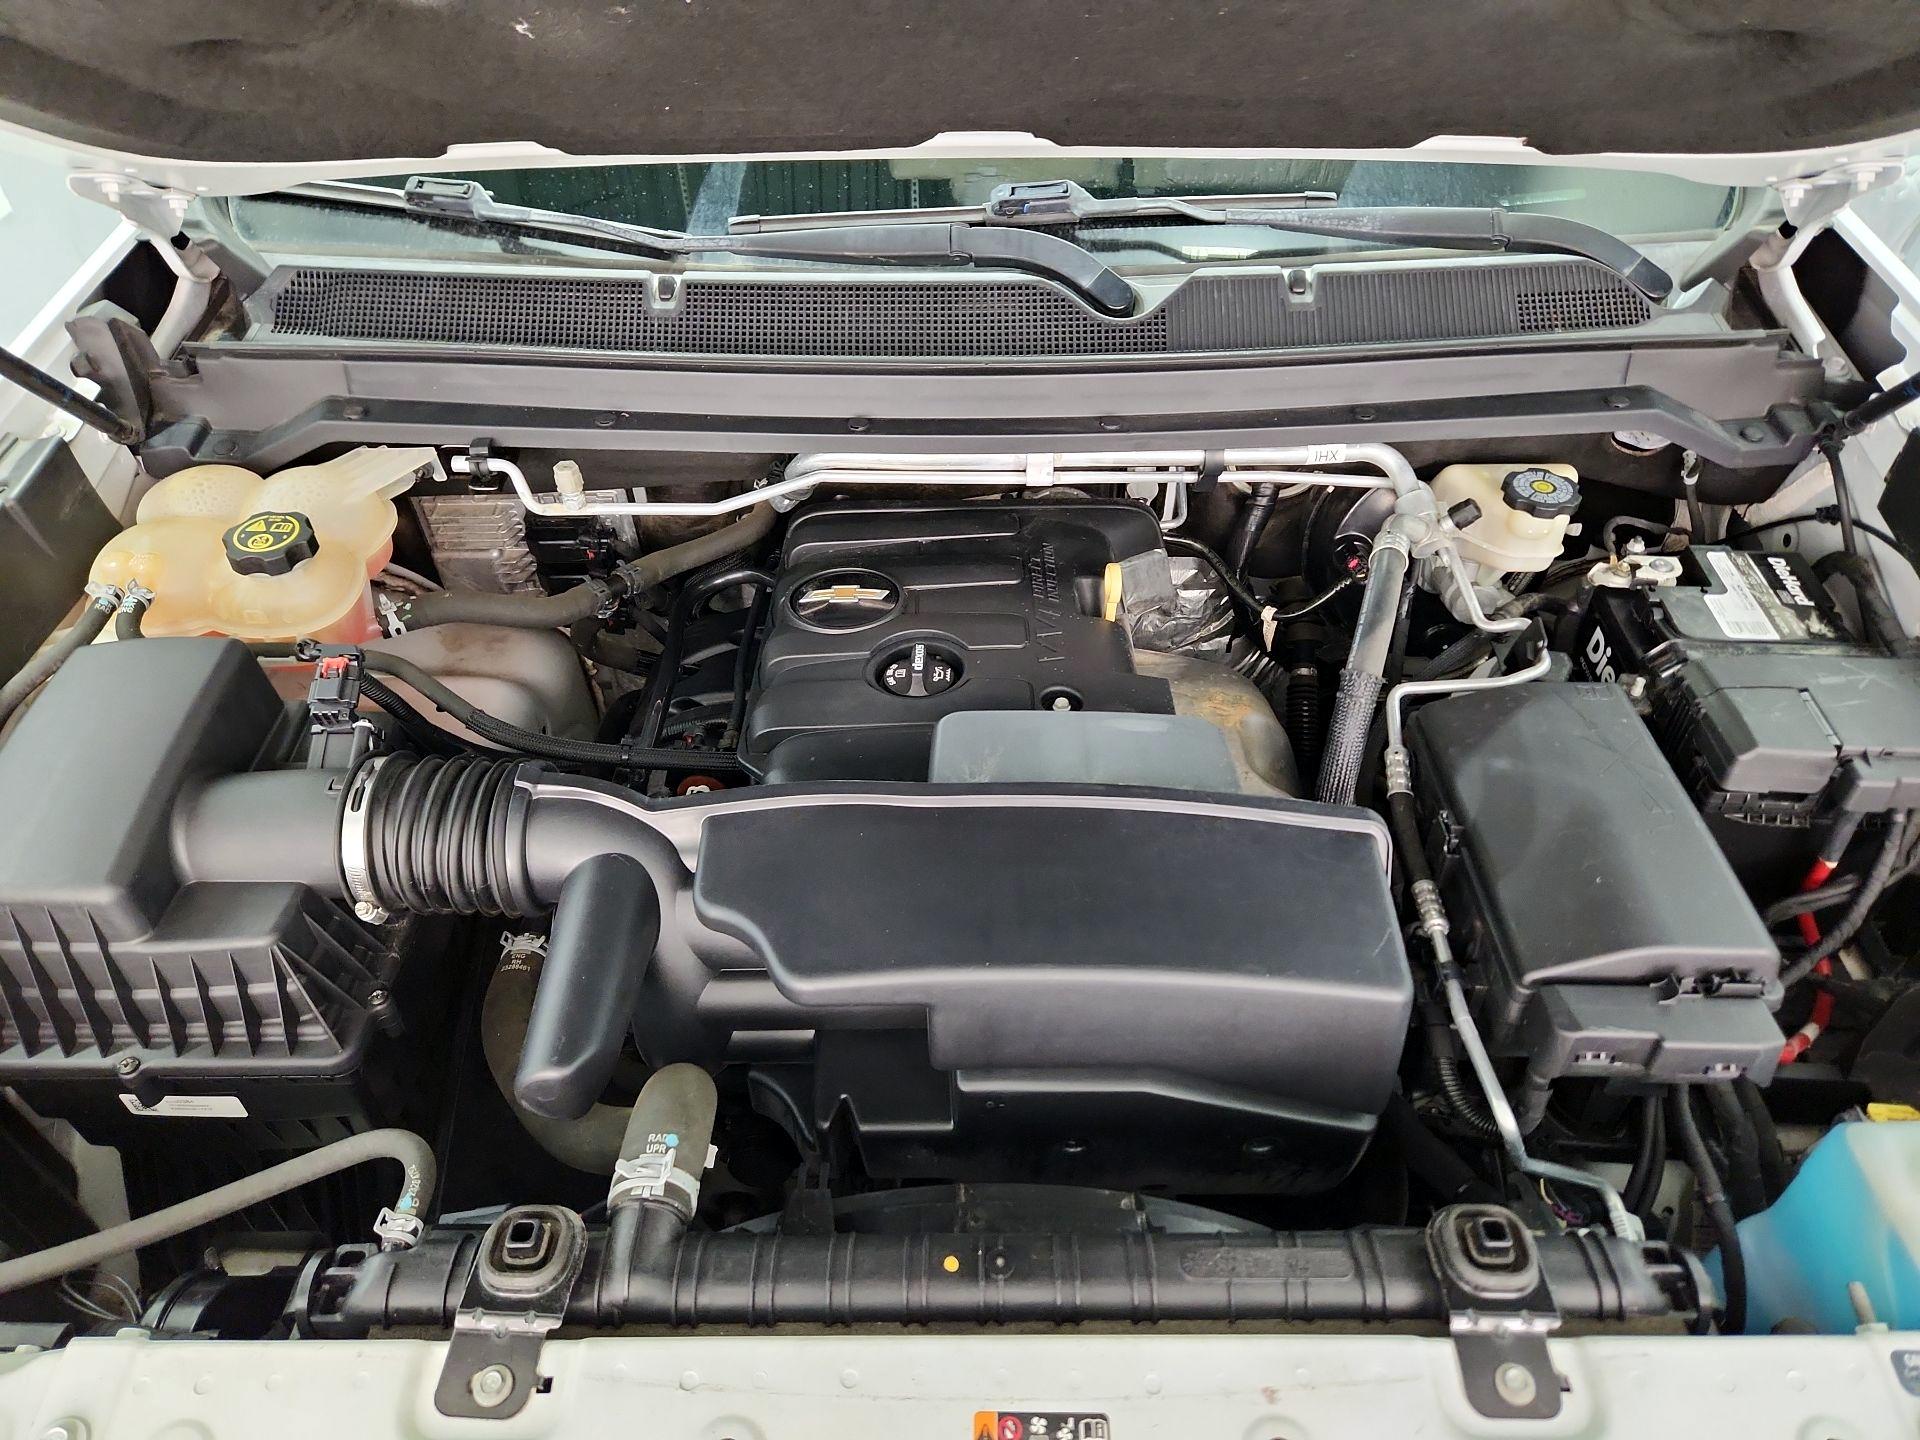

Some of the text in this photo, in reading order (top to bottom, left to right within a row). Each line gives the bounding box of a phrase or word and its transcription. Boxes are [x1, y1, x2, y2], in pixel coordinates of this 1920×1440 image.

[1767, 557, 1816, 607] DieHard
[912, 643, 925, 671] dexos
[646, 1143, 667, 1154] UPR
